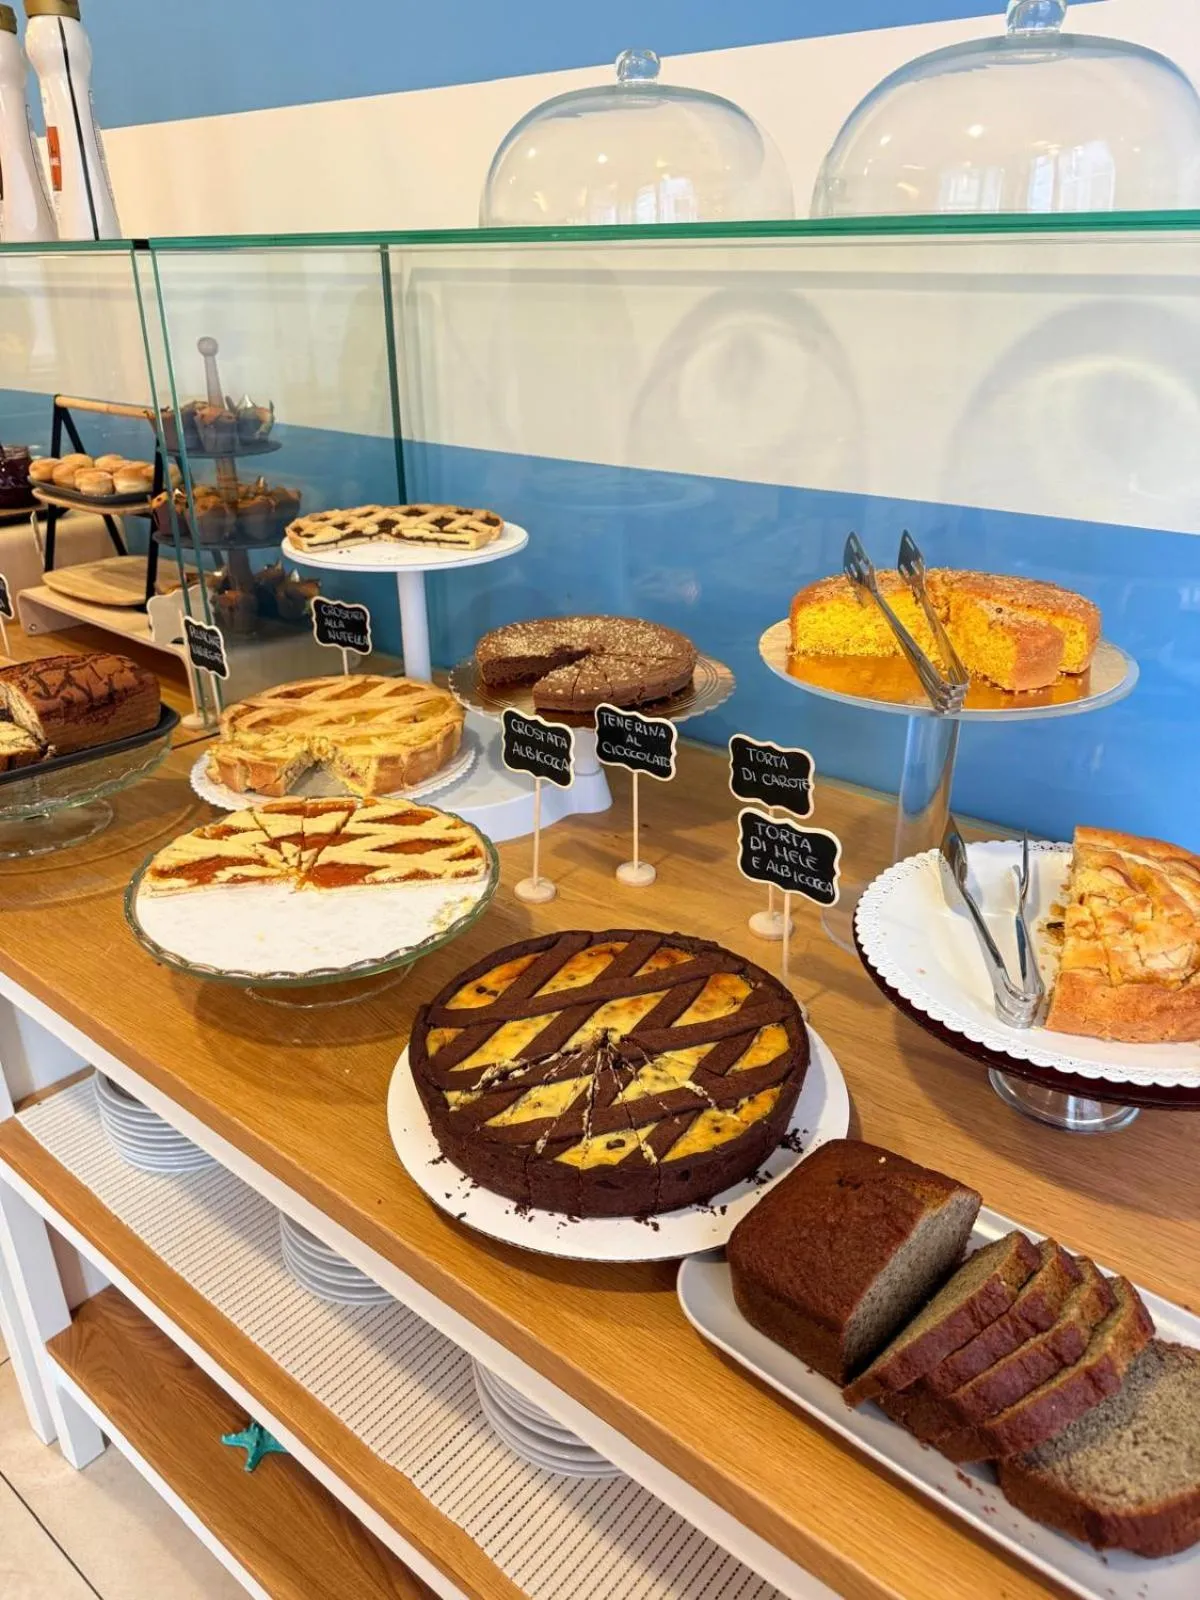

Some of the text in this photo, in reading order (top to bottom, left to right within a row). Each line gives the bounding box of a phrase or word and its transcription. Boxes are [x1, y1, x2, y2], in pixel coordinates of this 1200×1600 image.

[511, 719, 568, 749] CROSTATA
[601, 712, 666, 739] TENERINA
[626, 734, 642, 747] AL
[746, 747, 788, 769] TORTA
[741, 767, 756, 782] DI
[750, 836, 766, 852] DI
[754, 822, 812, 853] TORTA
[752, 856, 762, 869] E
